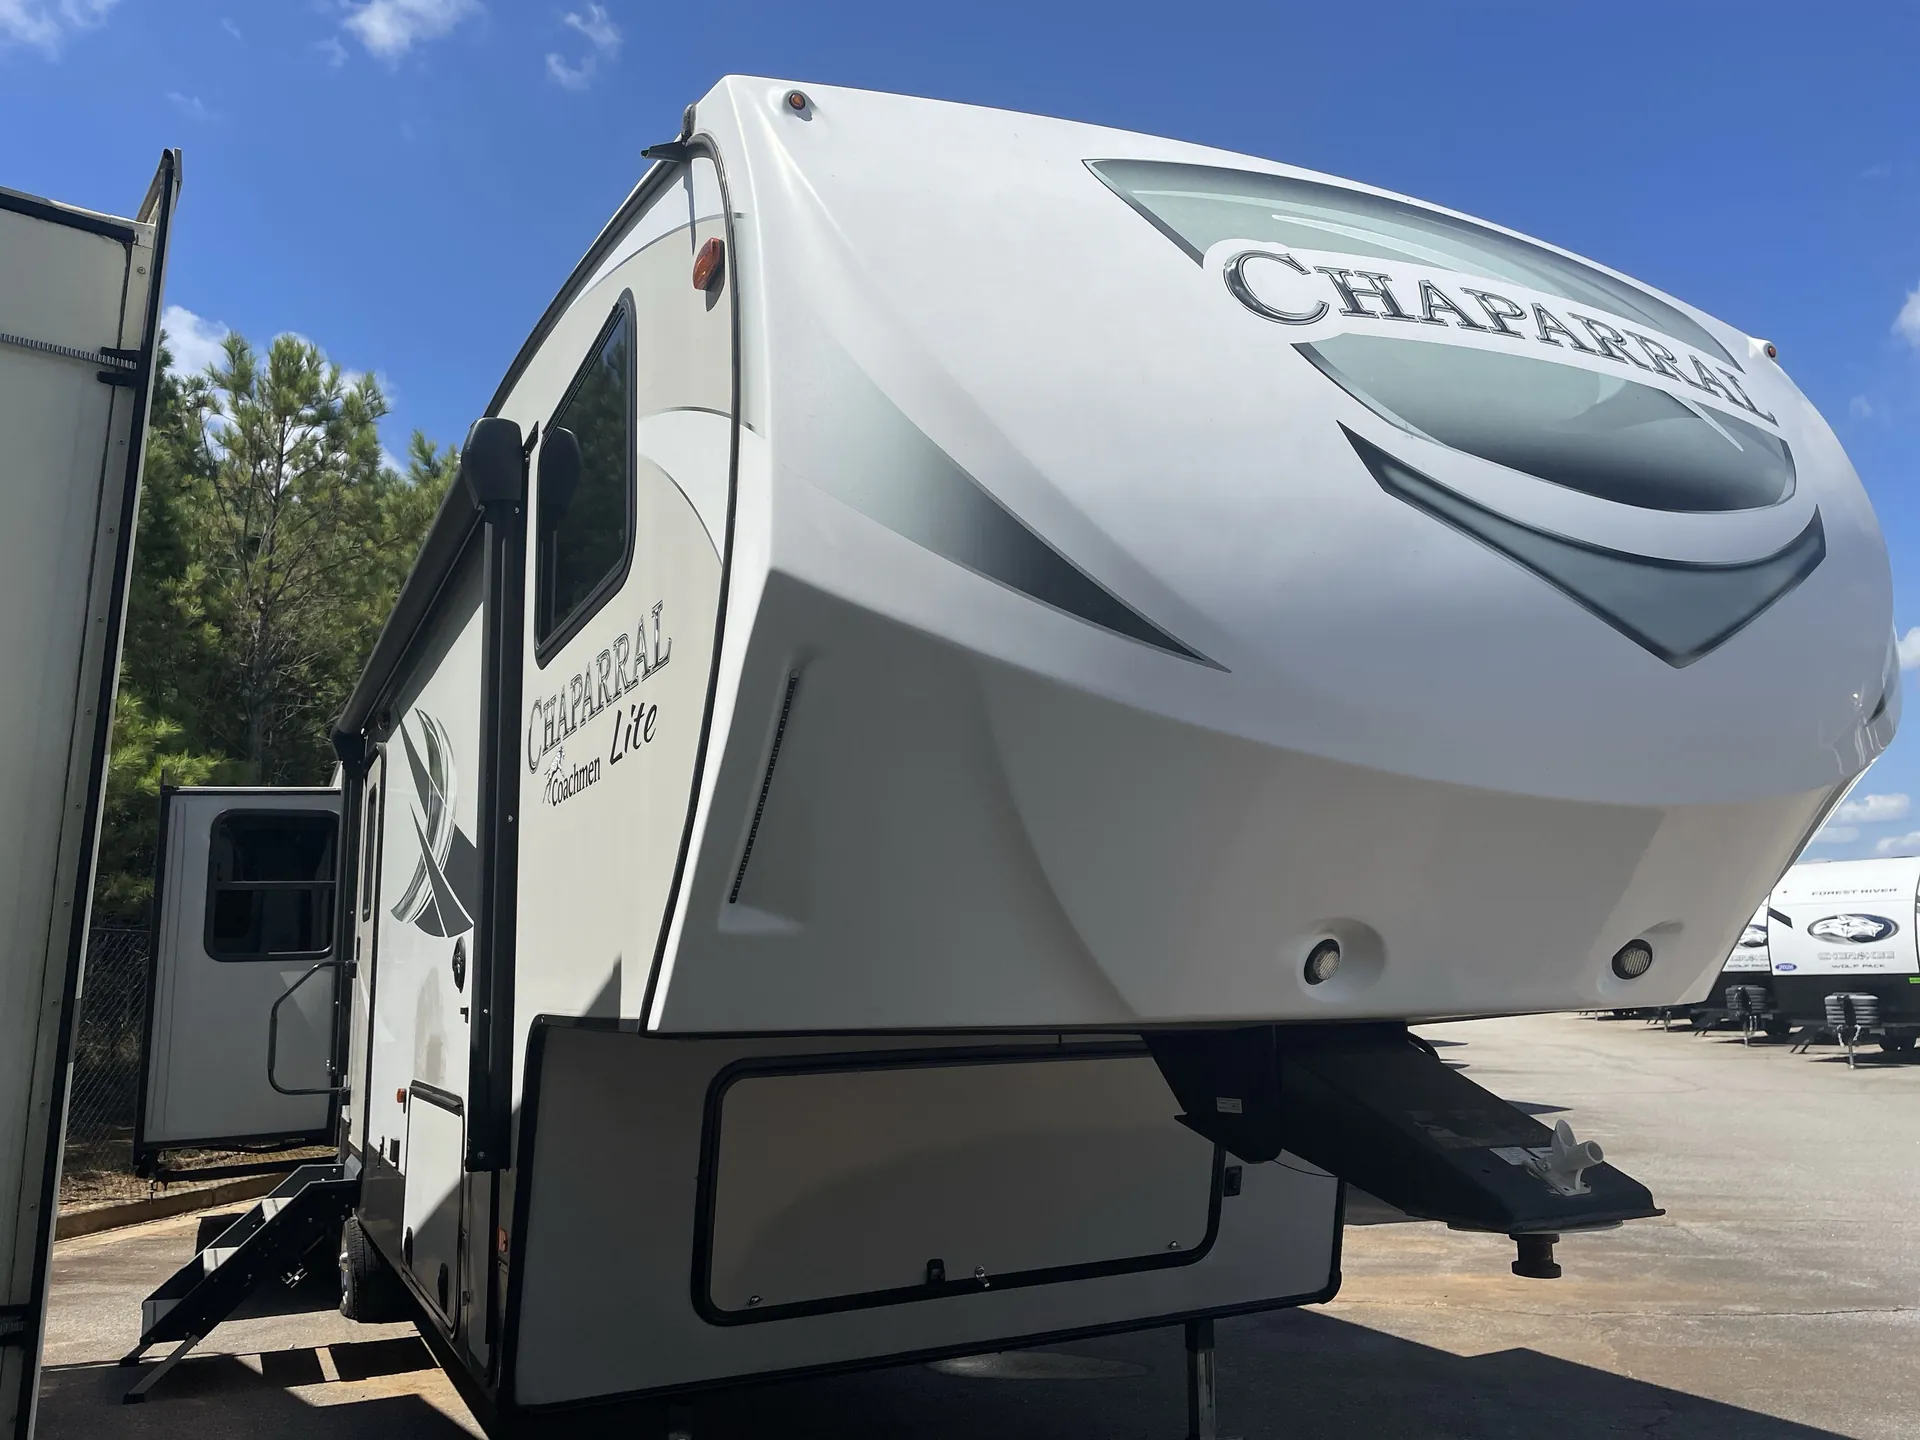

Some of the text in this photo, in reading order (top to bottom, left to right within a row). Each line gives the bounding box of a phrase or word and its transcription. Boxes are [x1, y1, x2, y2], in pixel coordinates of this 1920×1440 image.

[1223, 249, 1777, 426] CHAPARRAL
[527, 600, 672, 774] CHAPARRAL
[609, 702, 658, 766] Lite
[551, 756, 601, 807] Coachmen
